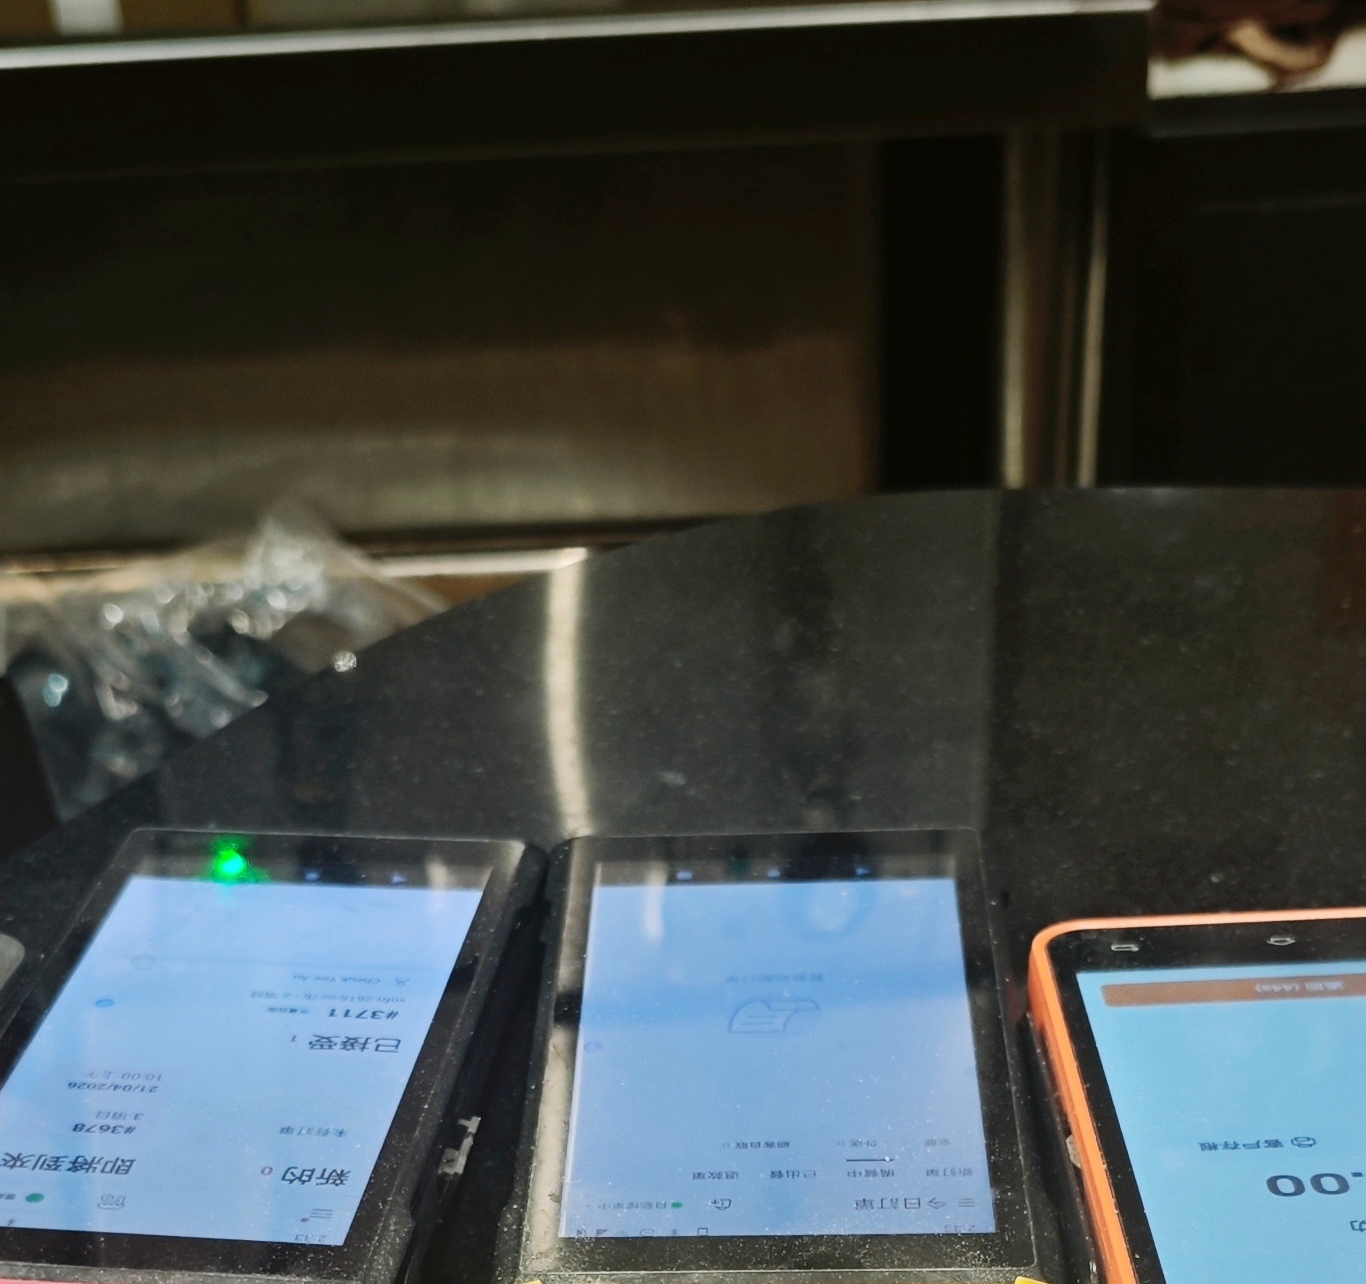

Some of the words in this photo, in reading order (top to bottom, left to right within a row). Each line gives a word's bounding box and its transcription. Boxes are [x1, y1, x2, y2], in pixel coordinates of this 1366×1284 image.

[327, 1008, 399, 1019] #3711
[307, 1034, 402, 1053] 已接受
[67, 1082, 159, 1093] 21/04/2026
[72, 1123, 137, 1135] #3678
[281, 1166, 351, 1187] 新的
[853, 1197, 947, 1210] 今日訂單
